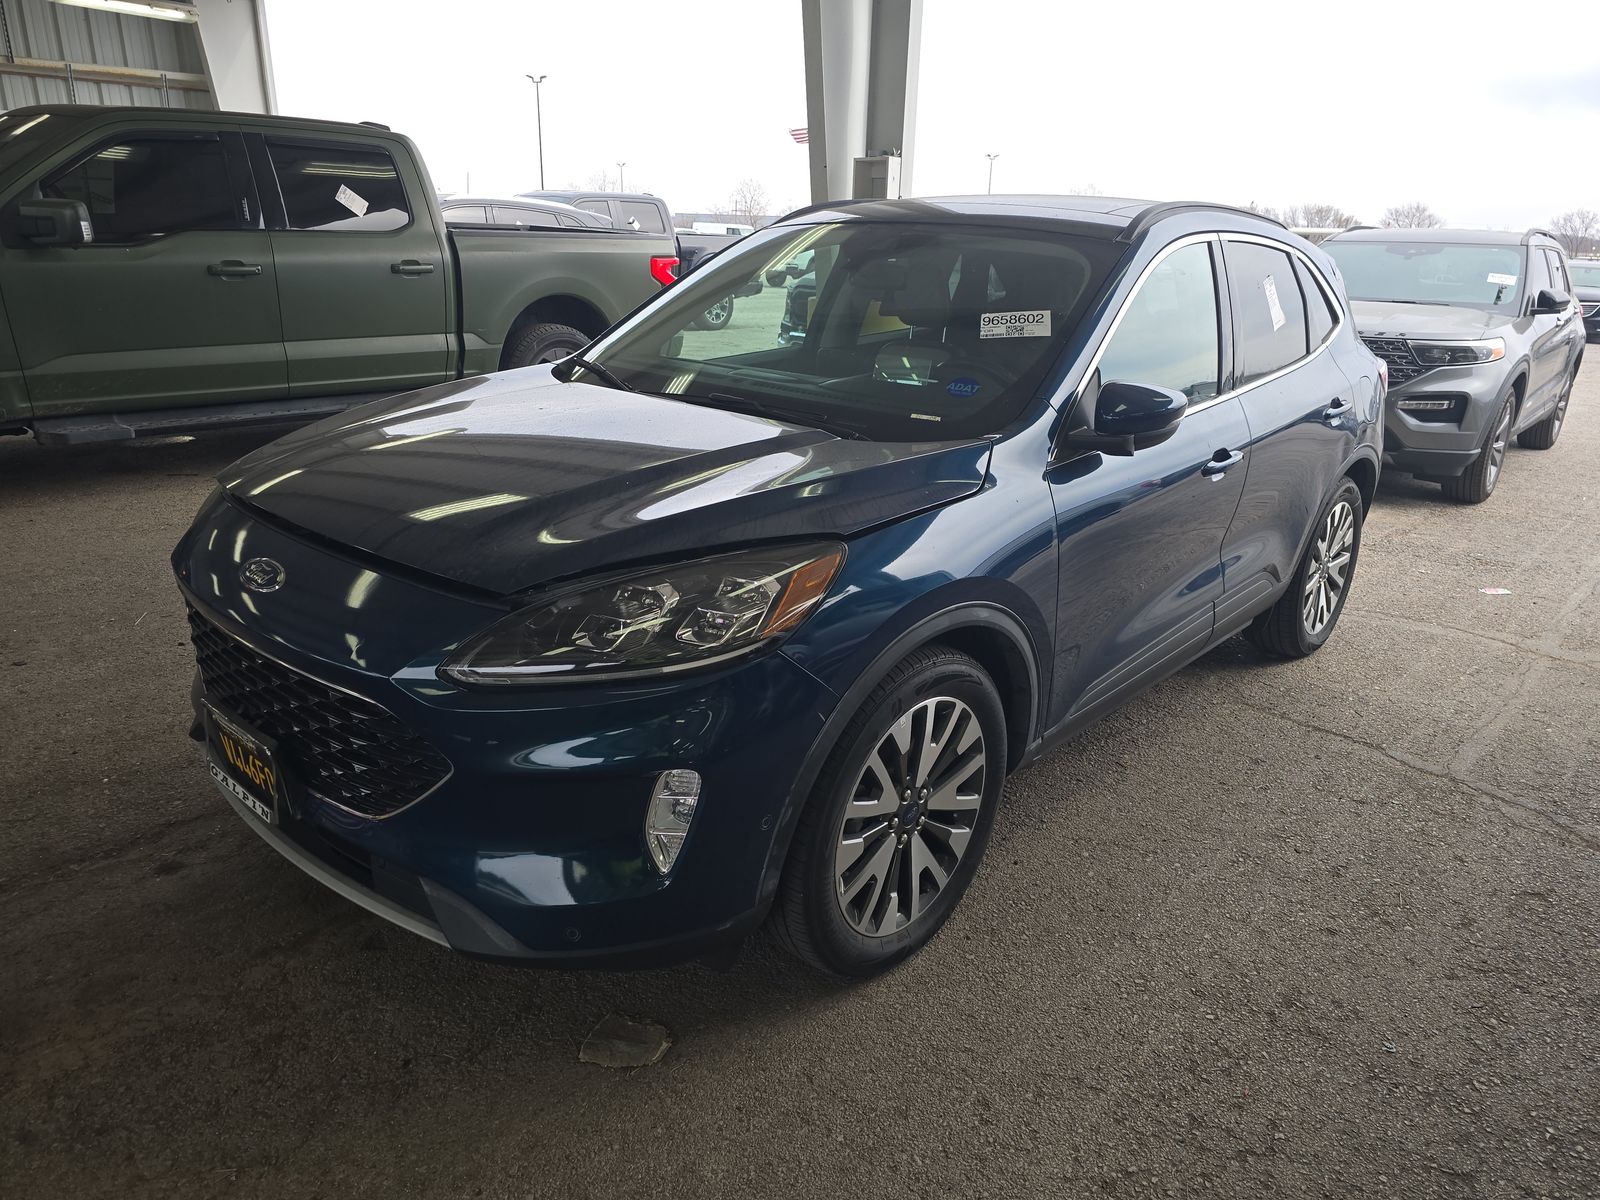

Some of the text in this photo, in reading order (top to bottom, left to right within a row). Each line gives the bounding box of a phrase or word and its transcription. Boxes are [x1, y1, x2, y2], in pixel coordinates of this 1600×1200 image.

[982, 313, 1044, 326] 9658602
[946, 382, 982, 393] ADAT
[211, 765, 270, 820] GALPIN
